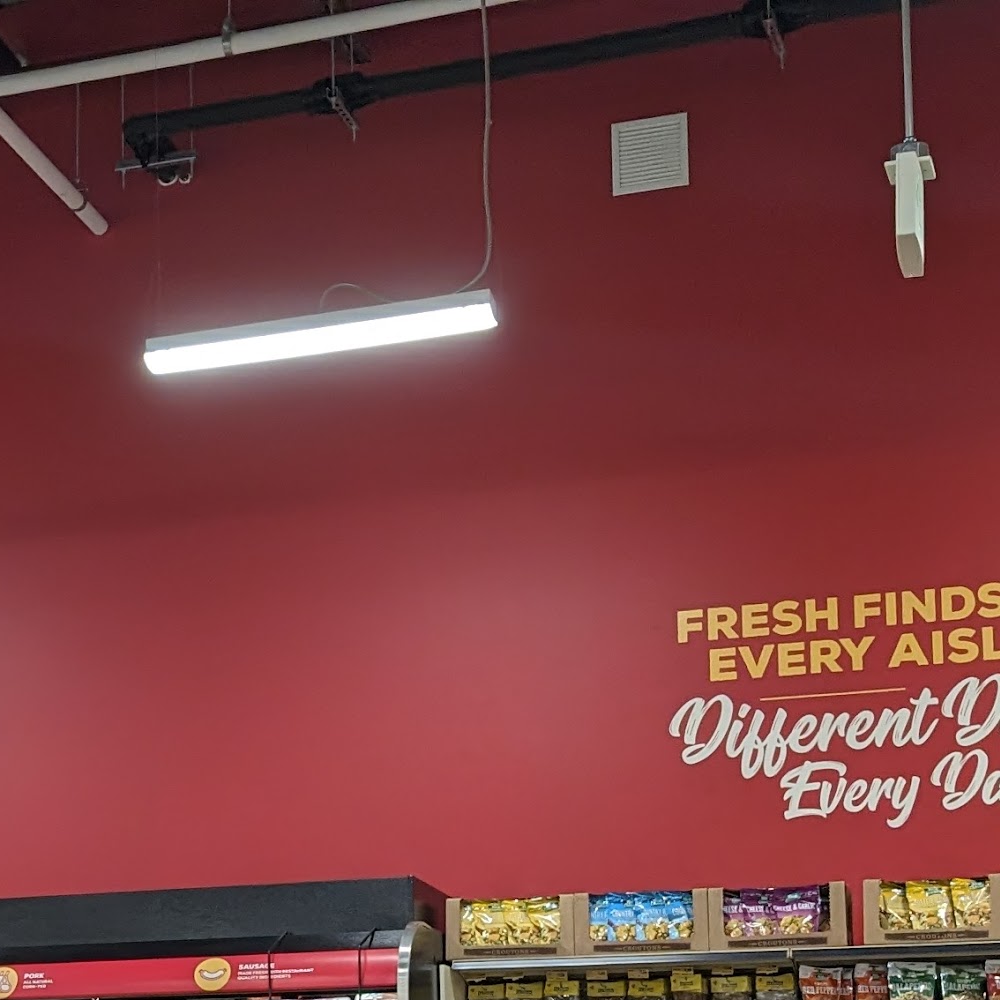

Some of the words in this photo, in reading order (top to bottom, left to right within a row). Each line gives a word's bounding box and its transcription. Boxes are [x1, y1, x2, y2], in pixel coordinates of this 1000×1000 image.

[677, 600, 839, 643] FRESH
[853, 582, 1000, 628] FINDS
[709, 635, 876, 682] EVERY
[668, 687, 939, 779] Different
[779, 760, 921, 828] Every
[238, 962, 275, 970] SAUSAGE
